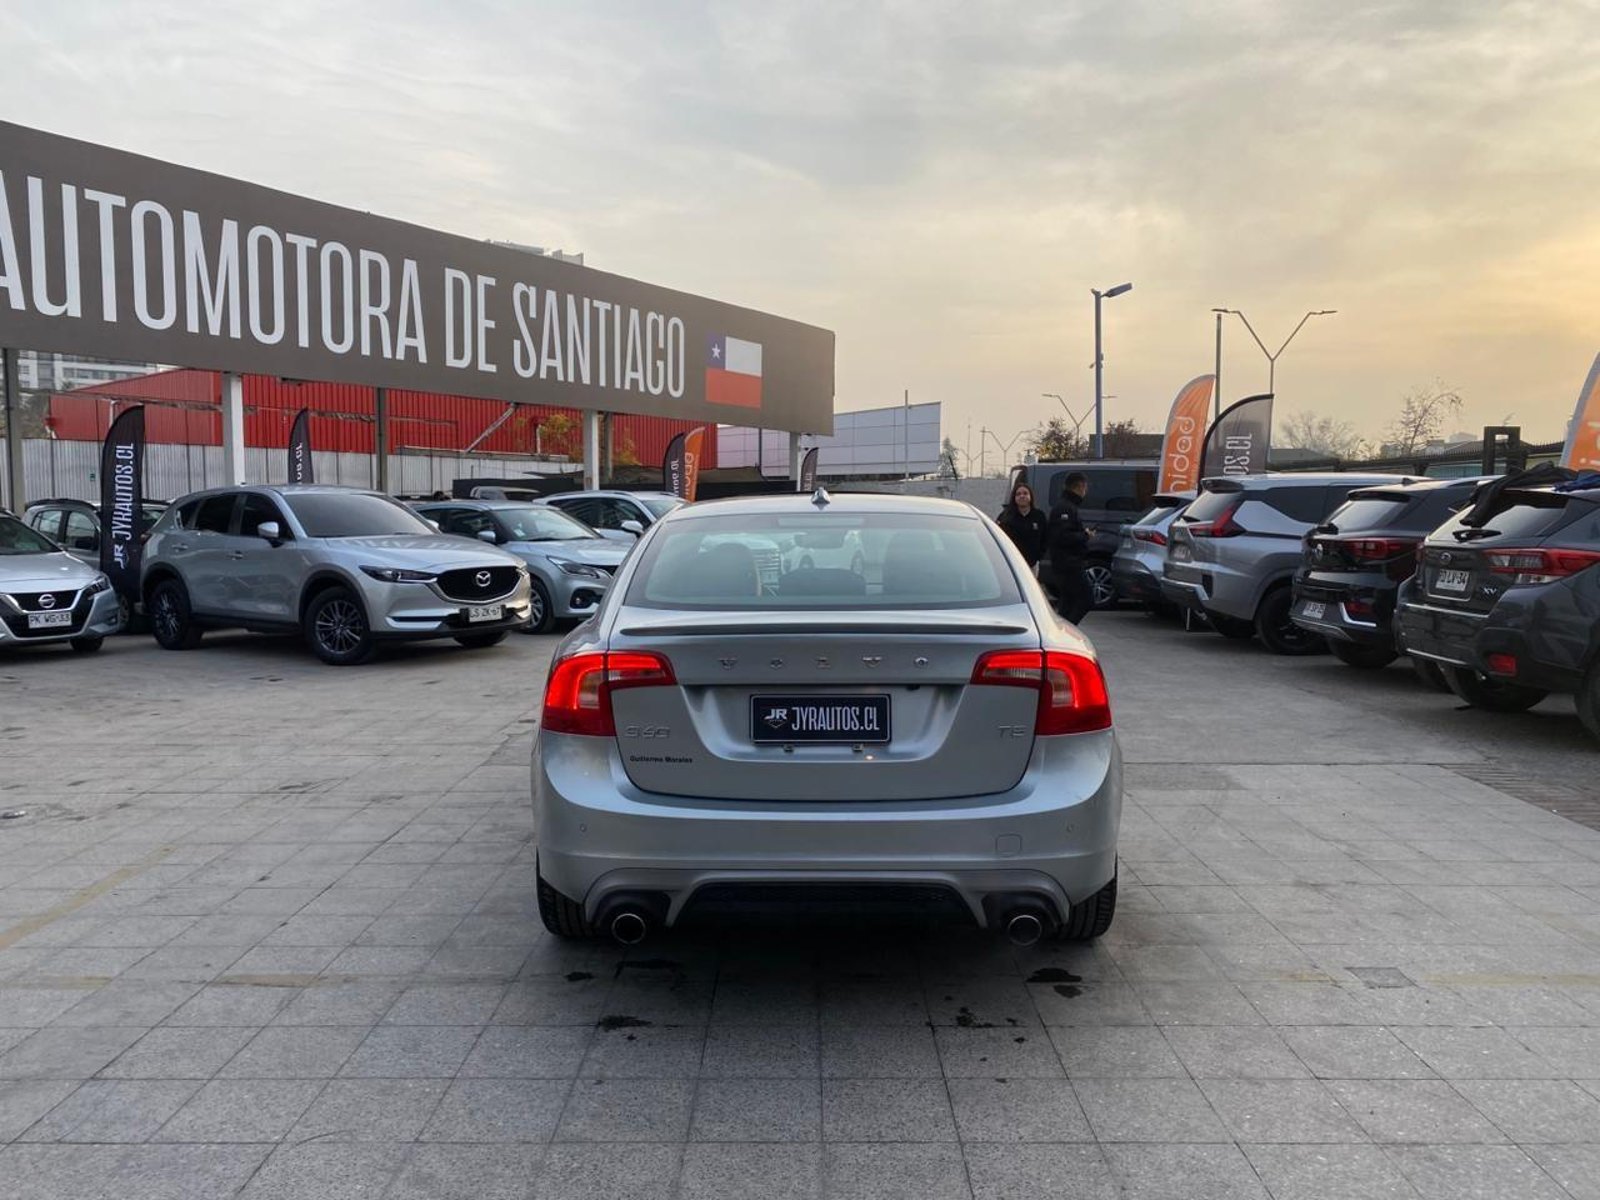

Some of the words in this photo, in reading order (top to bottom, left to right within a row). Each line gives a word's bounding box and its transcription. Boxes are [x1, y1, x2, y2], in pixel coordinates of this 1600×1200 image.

[445, 267, 497, 372] DE
[513, 281, 685, 398] SANTIAGO
[111, 442, 134, 541] JYRAUTOS.CL
[718, 656, 929, 670] VOLVO
[764, 708, 787, 720] JR
[791, 706, 880, 731] JYRAUTOS.CL
